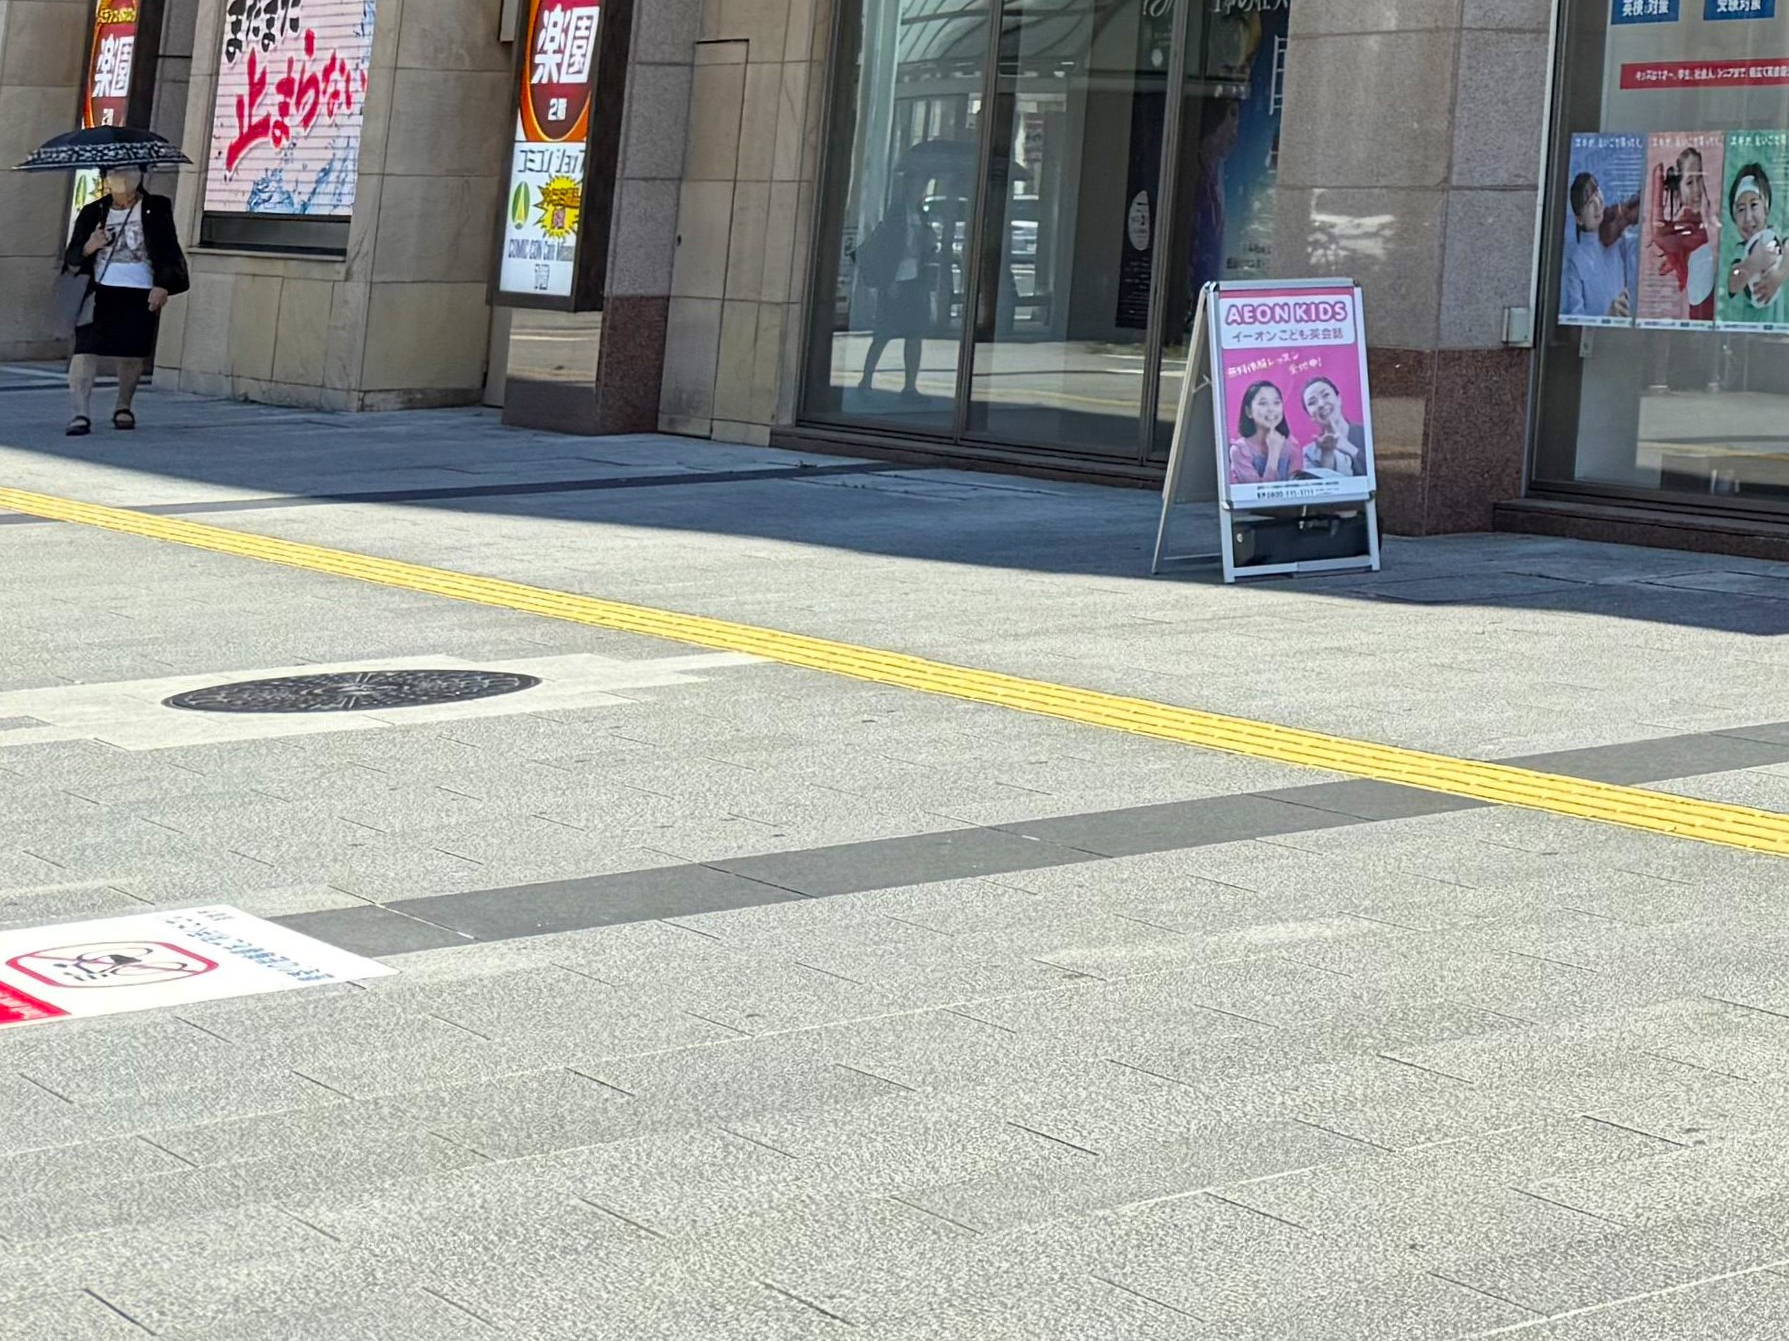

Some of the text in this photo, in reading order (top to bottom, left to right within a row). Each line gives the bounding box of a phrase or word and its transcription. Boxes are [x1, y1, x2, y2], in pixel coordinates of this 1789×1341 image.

[92, 33, 135, 98] 楽園
[531, 3, 600, 85] 楽園
[225, 27, 368, 175] 止まらない
[1226, 301, 1347, 325] AEON KIDS
